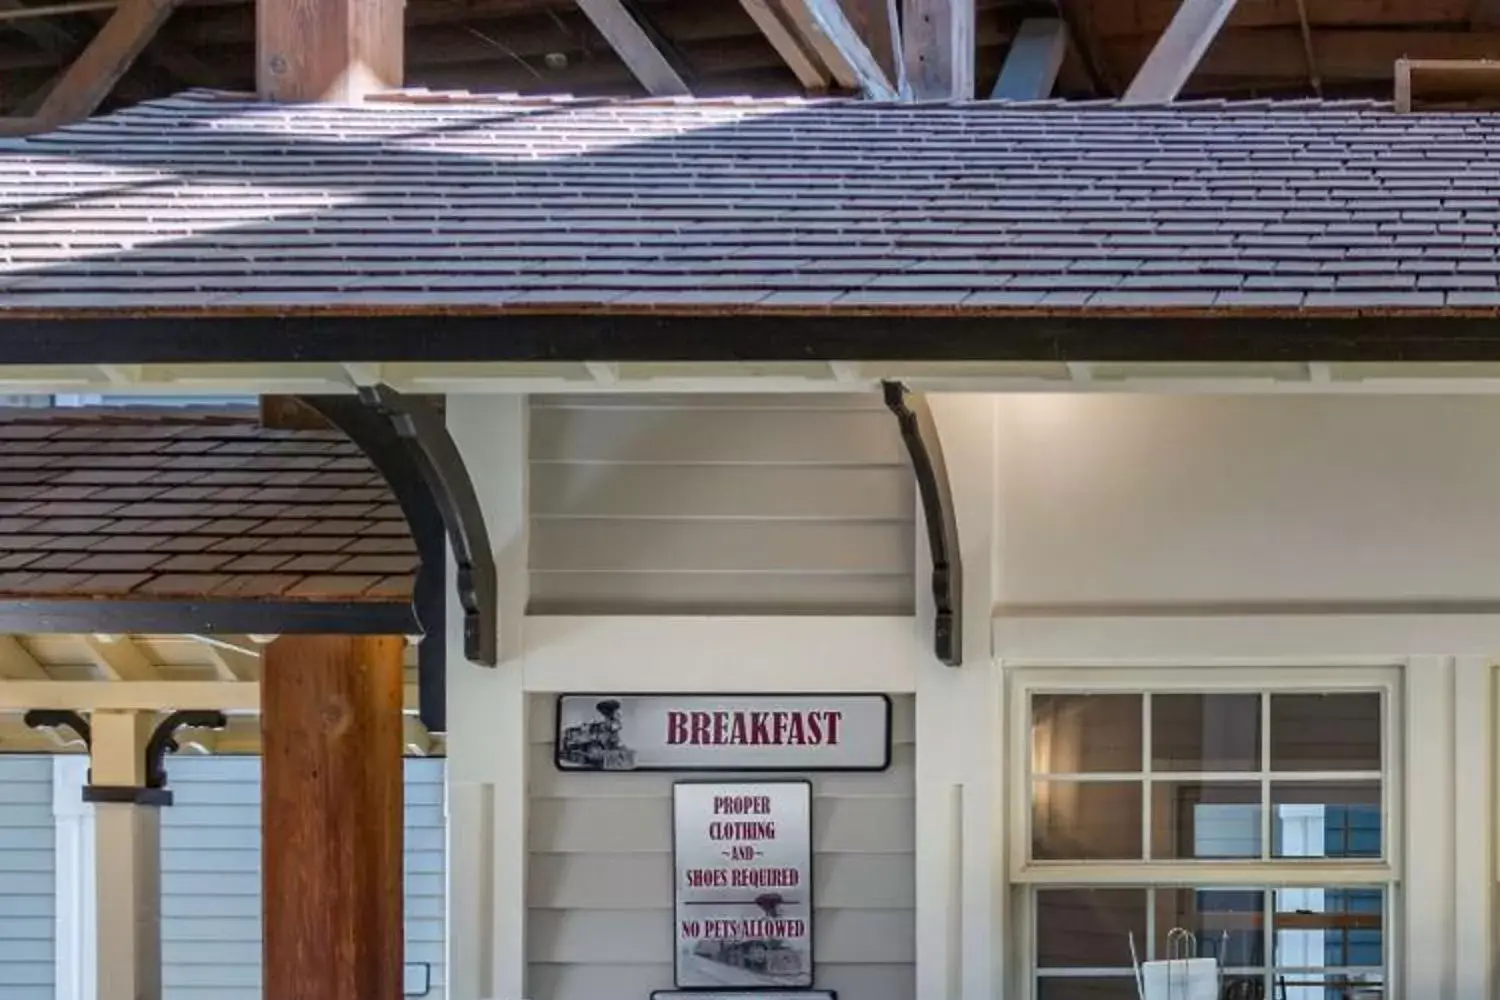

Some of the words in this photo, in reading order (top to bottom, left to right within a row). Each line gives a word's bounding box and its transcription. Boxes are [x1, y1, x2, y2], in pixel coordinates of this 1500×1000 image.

[666, 711, 842, 746] BREAKFAST
[713, 796, 771, 815] PROPER
[709, 821, 775, 841] CLOTHING
[686, 869, 728, 887] SHOES
[731, 869, 799, 888] REQUIRED
[681, 920, 700, 938] NO
[704, 920, 739, 938] PETS
[742, 920, 805, 938] ALLOWED
